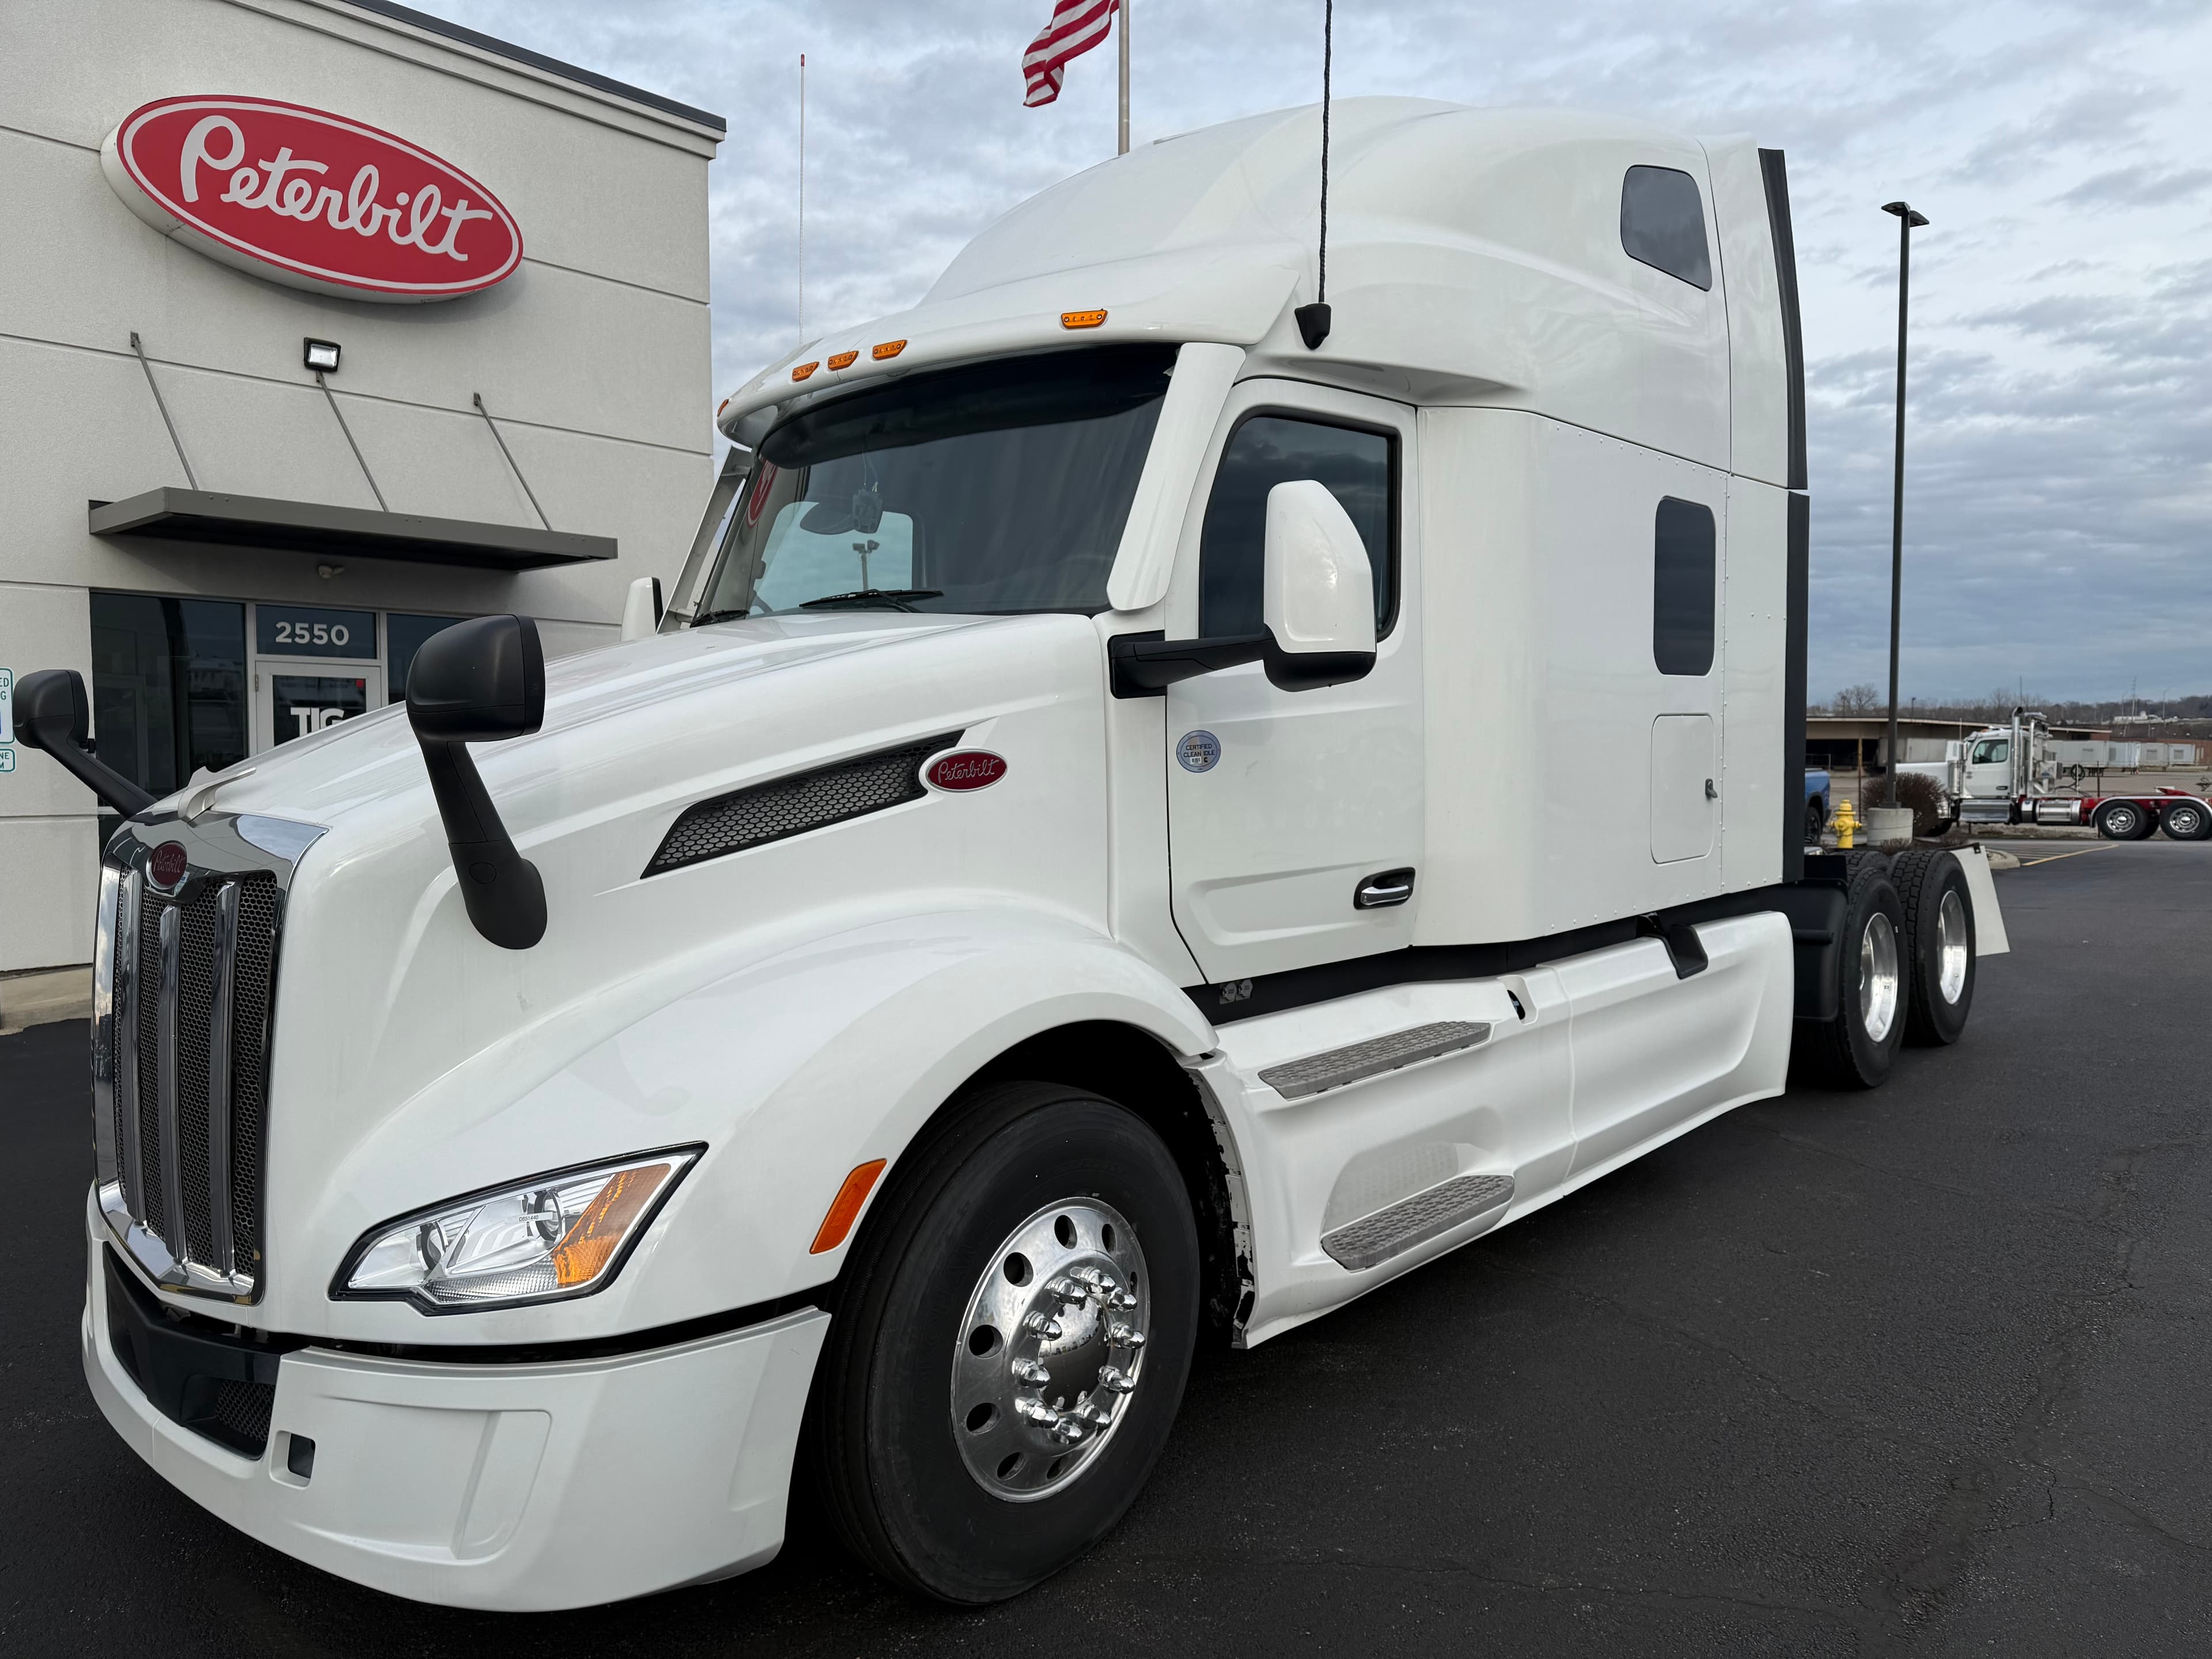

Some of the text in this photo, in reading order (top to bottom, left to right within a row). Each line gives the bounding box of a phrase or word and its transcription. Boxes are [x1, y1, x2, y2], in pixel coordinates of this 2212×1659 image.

[180, 115, 493, 261] Peterbilt
[275, 622, 349, 646] 2550
[938, 759, 1000, 784] Peterbilt
